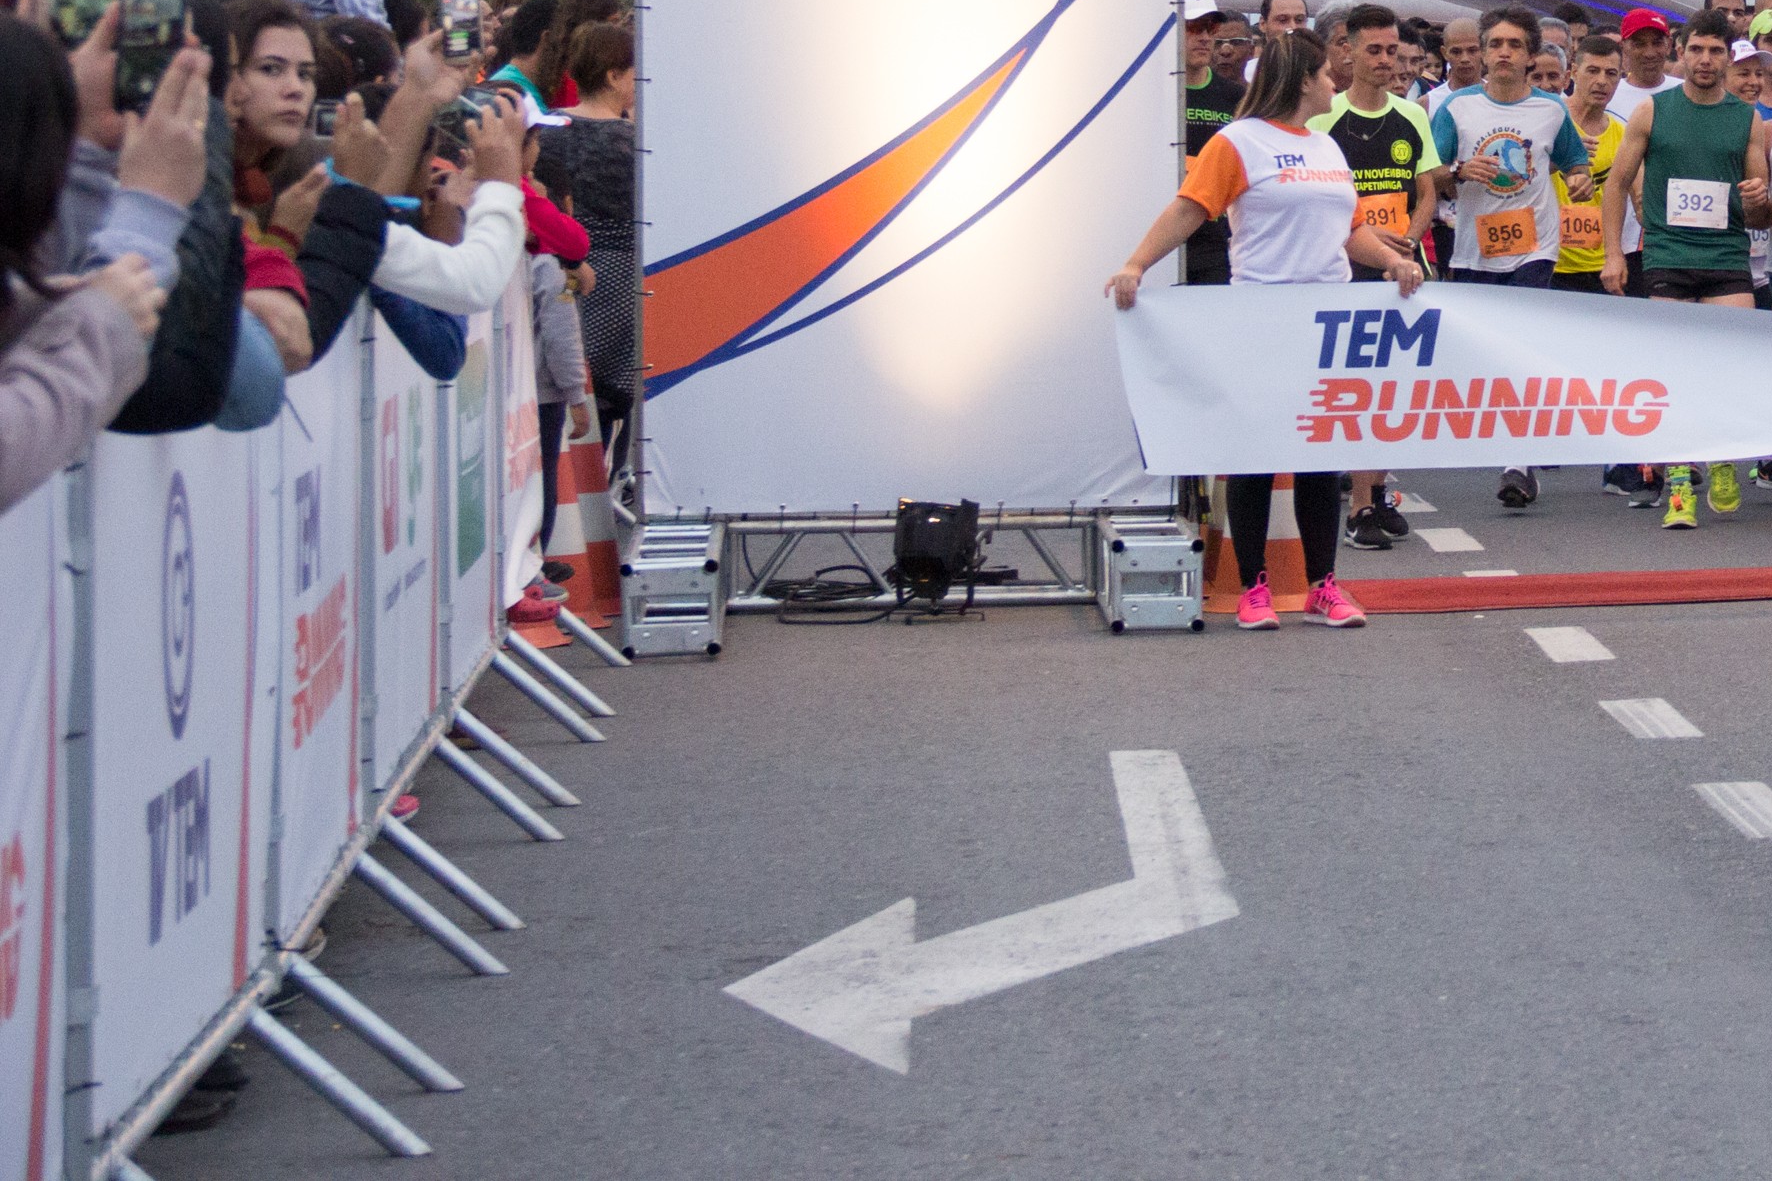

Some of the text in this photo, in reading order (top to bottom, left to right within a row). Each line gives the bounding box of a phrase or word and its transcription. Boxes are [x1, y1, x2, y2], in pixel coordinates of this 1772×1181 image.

[1274, 154, 1306, 169] TEM
[1364, 168, 1413, 180] NOVEMBRO
[1353, 180, 1403, 191] TAPETININGA
[1678, 193, 1714, 212] 392
[1365, 207, 1398, 226] 891
[1562, 217, 1601, 235] 1064
[1488, 223, 1523, 243] 856
[1314, 308, 1442, 370] TEM
[1296, 377, 1670, 443] RUNNING
